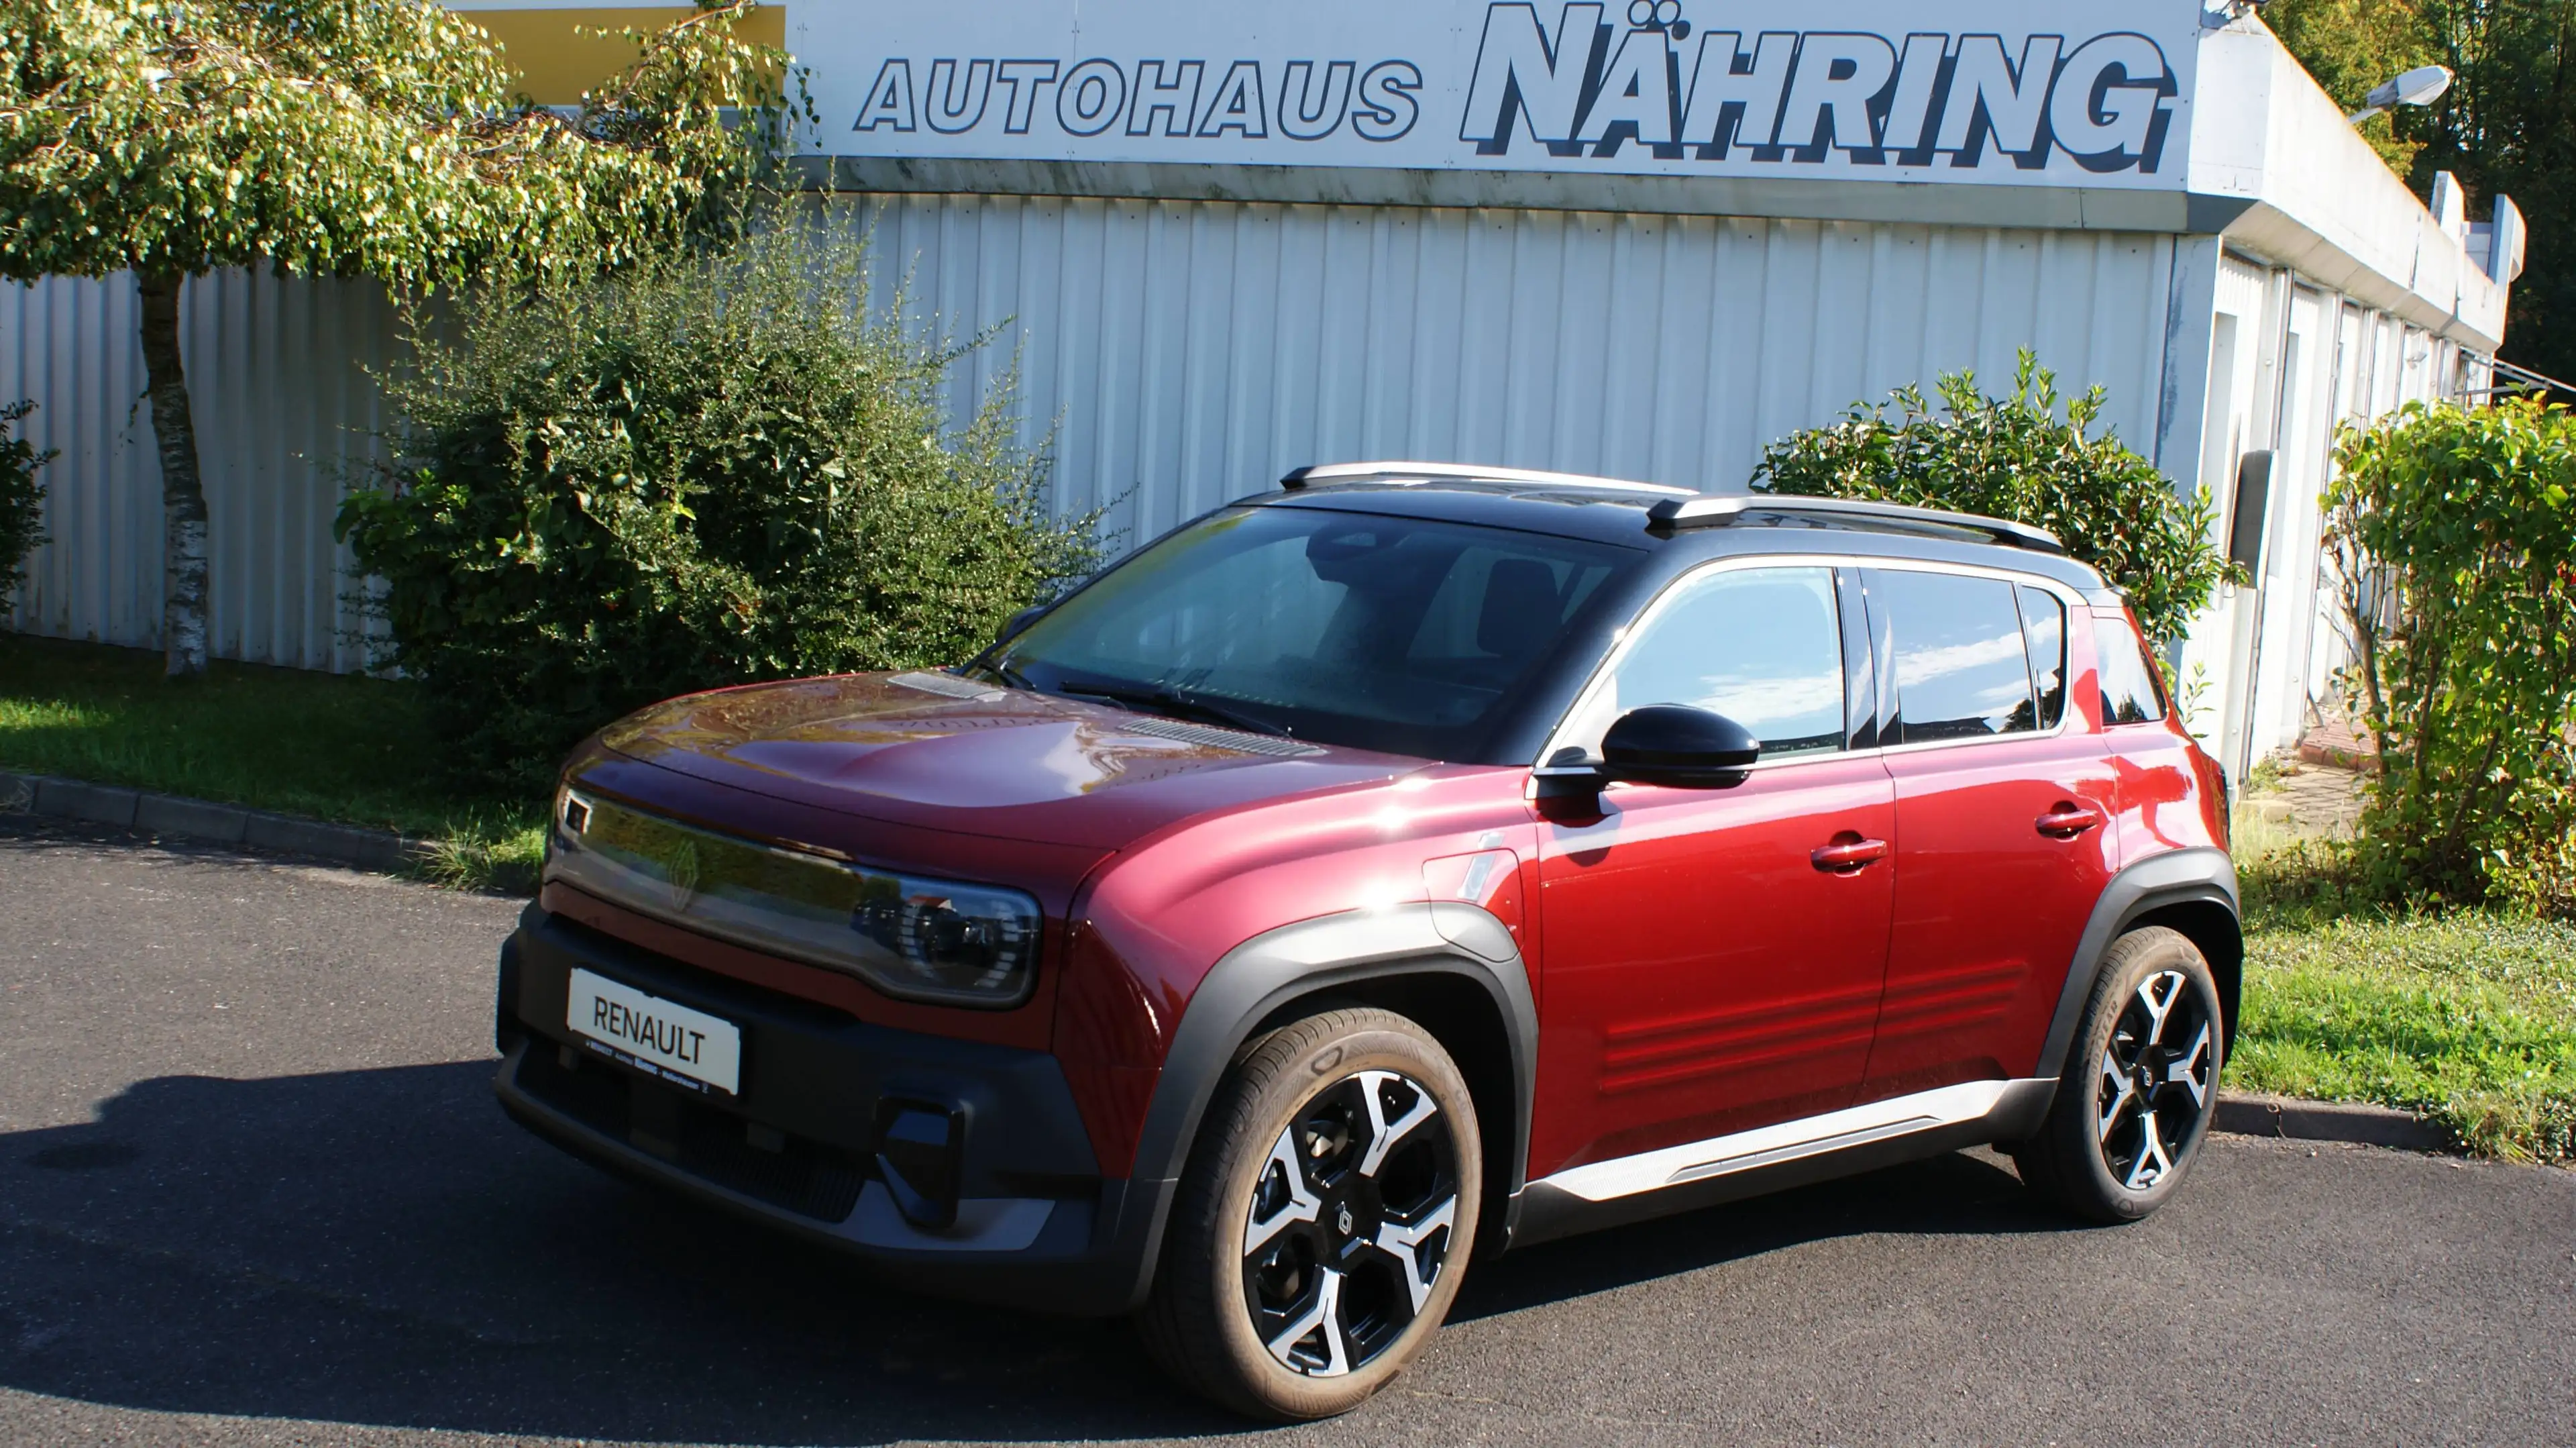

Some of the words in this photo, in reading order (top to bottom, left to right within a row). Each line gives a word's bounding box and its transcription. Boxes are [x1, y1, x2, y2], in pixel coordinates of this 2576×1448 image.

[853, 58, 1423, 142] AUTOHAUS
[1458, 0, 2179, 174] NÄHRING
[594, 996, 706, 1065] RENAULT
